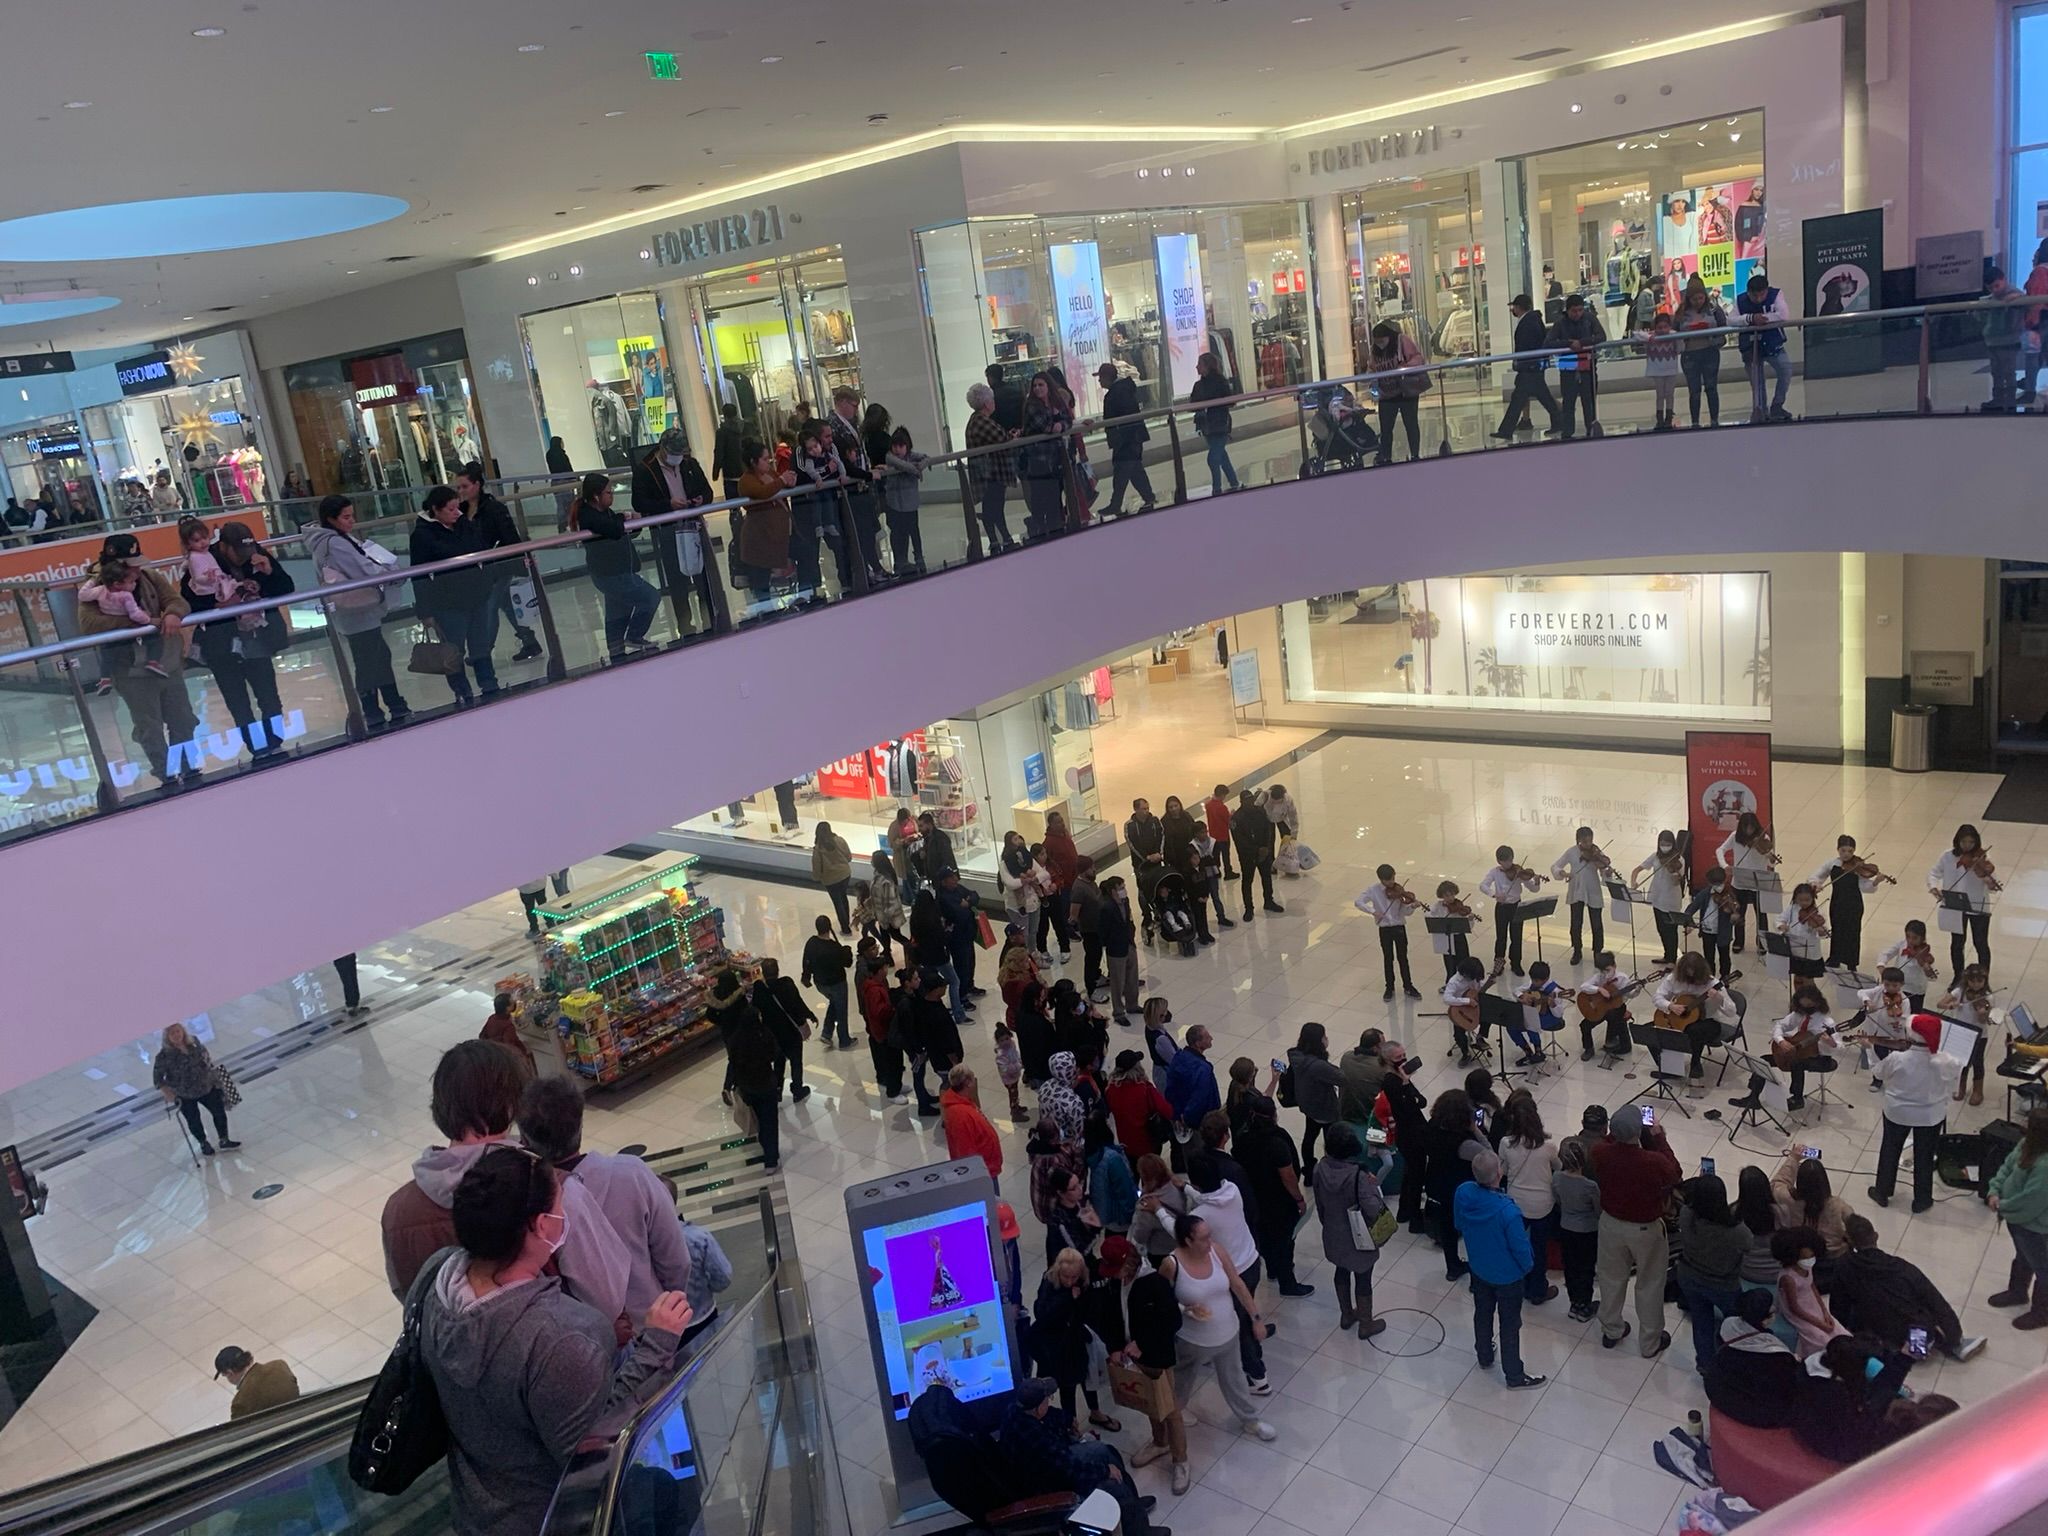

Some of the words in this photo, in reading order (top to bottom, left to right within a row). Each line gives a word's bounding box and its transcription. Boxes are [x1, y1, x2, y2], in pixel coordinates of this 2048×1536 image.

[1308, 131, 1407, 176] FOREVER
[1411, 124, 1440, 156] 21
[651, 213, 752, 268] FOREVER
[752, 204, 783, 245] 21
[1817, 248, 1835, 257] PET
[1836, 243, 1868, 254] NIGHTS
[1817, 256, 1839, 264] WITH
[1841, 252, 1869, 261] SANTA
[1702, 251, 1731, 278] GIVE
[1068, 295, 1093, 312] HELLO
[1173, 287, 1194, 306] SHOP
[1074, 339, 1097, 356] TODAY
[355, 386, 385, 403] COTTON
[1509, 612, 1668, 631] FOREVER21.COM
[1534, 633, 1558, 647] SHOP
[1560, 633, 1573, 647] 24
[1574, 634, 1606, 647] HOURS
[1607, 634, 1643, 648] ONLINE
[849, 763, 864, 778] OFF
[1701, 767, 1725, 775] WITH
[1728, 768, 1758, 777] SANTA
[1709, 759, 1748, 768] PHOTOS
